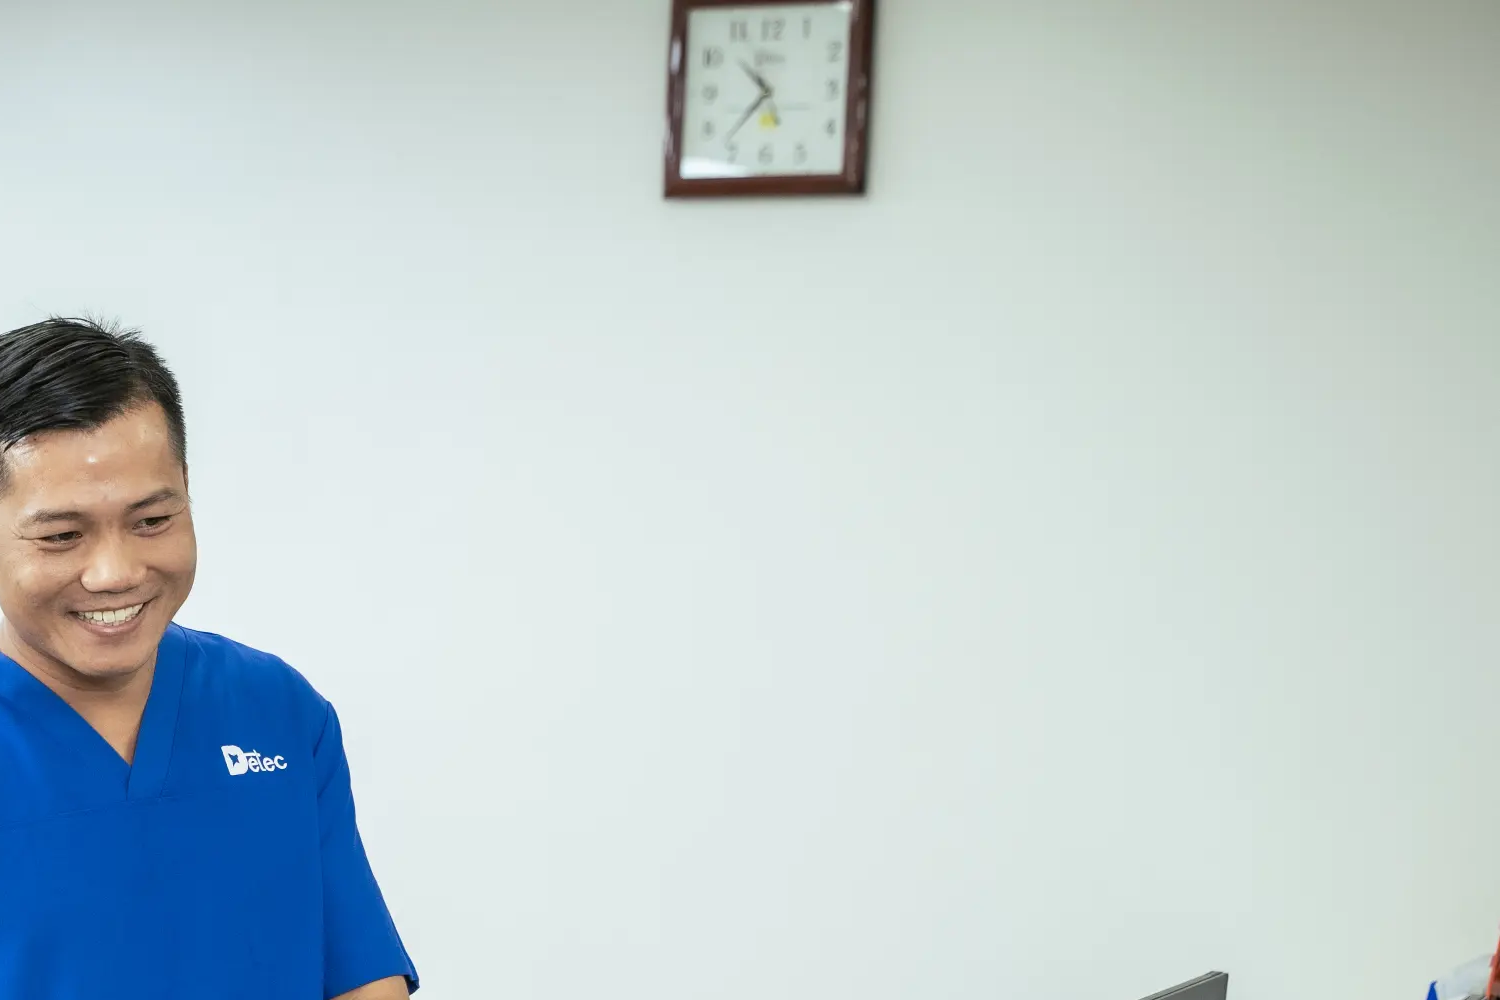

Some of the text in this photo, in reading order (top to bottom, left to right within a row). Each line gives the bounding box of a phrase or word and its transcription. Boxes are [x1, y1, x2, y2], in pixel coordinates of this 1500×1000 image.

[760, 18, 786, 41] 12
[802, 17, 812, 39] 1
[702, 46, 723, 68] 10
[221, 745, 288, 776] Detec
